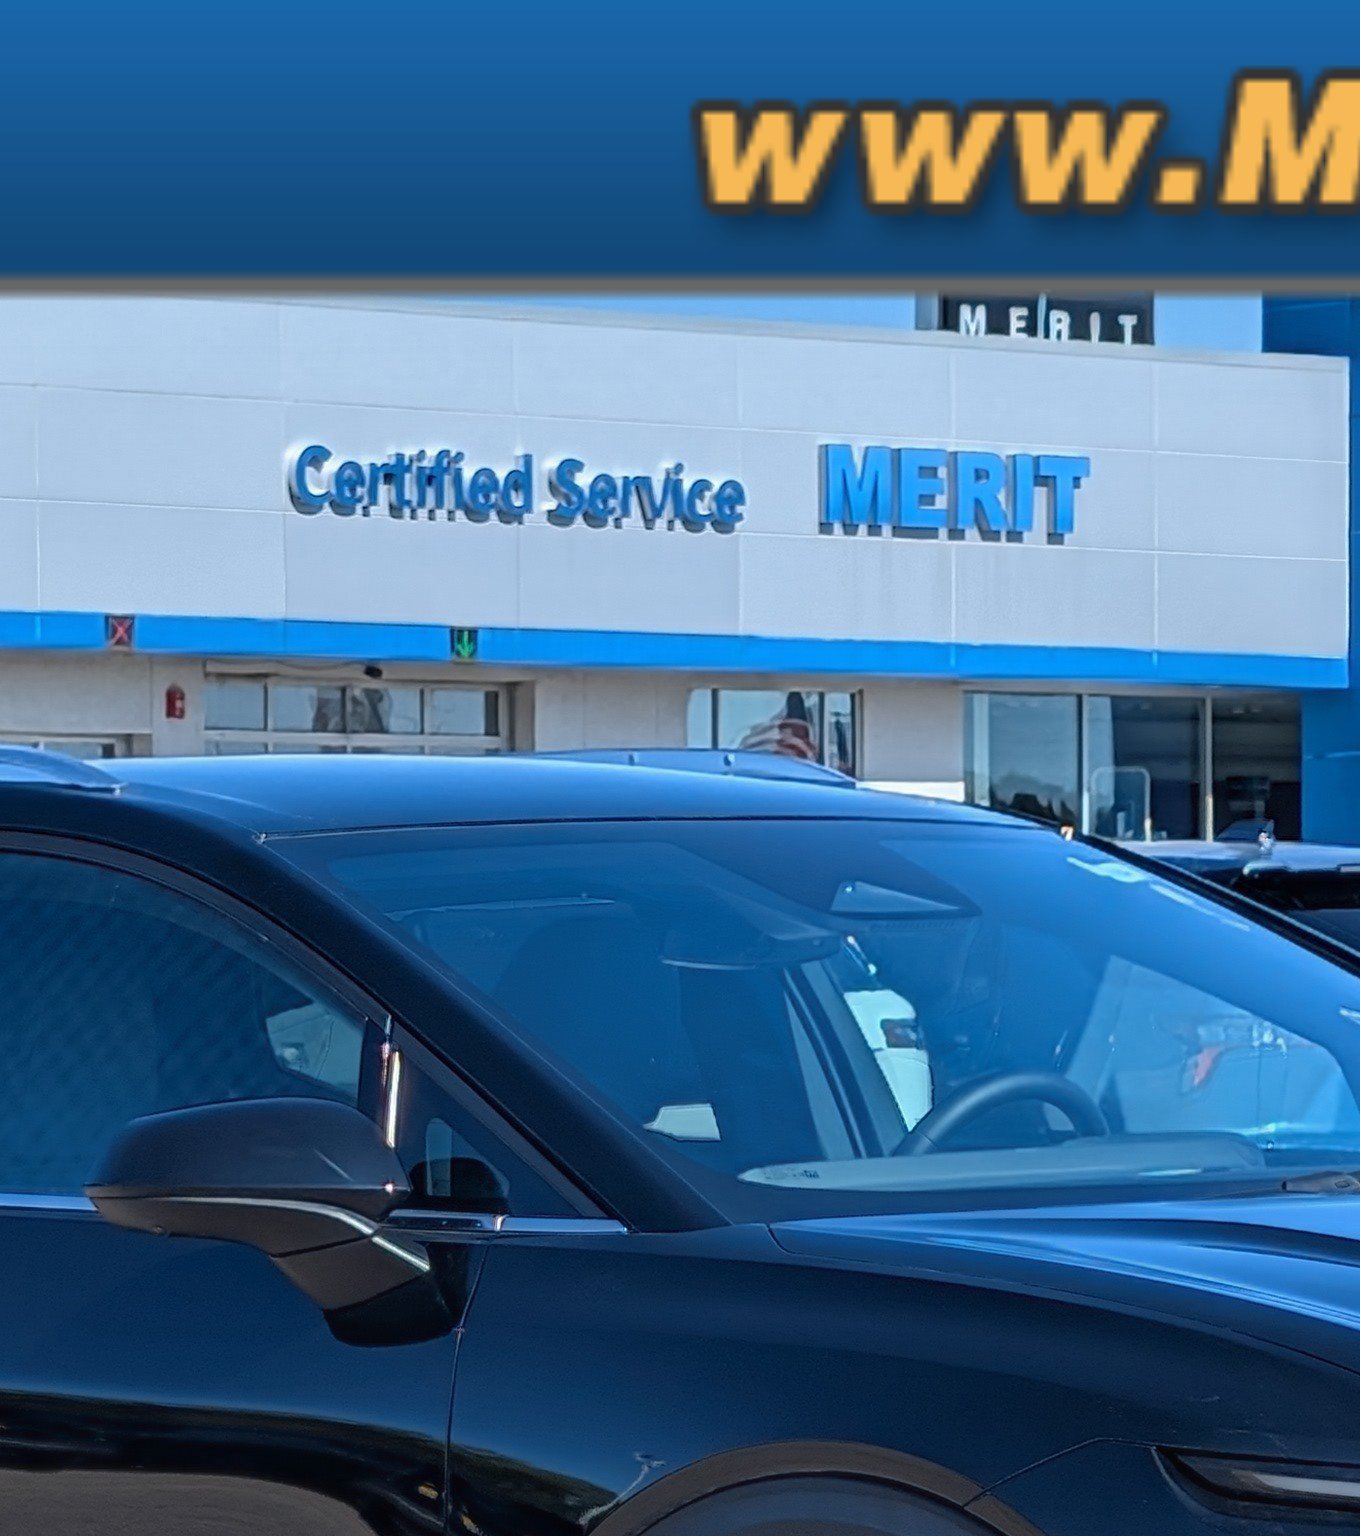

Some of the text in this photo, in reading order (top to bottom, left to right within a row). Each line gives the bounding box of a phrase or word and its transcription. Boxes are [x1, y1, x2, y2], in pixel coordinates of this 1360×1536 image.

[958, 303, 1138, 346] MERIT
[290, 444, 747, 531] Certified Service
[819, 443, 1091, 543] MERIT
